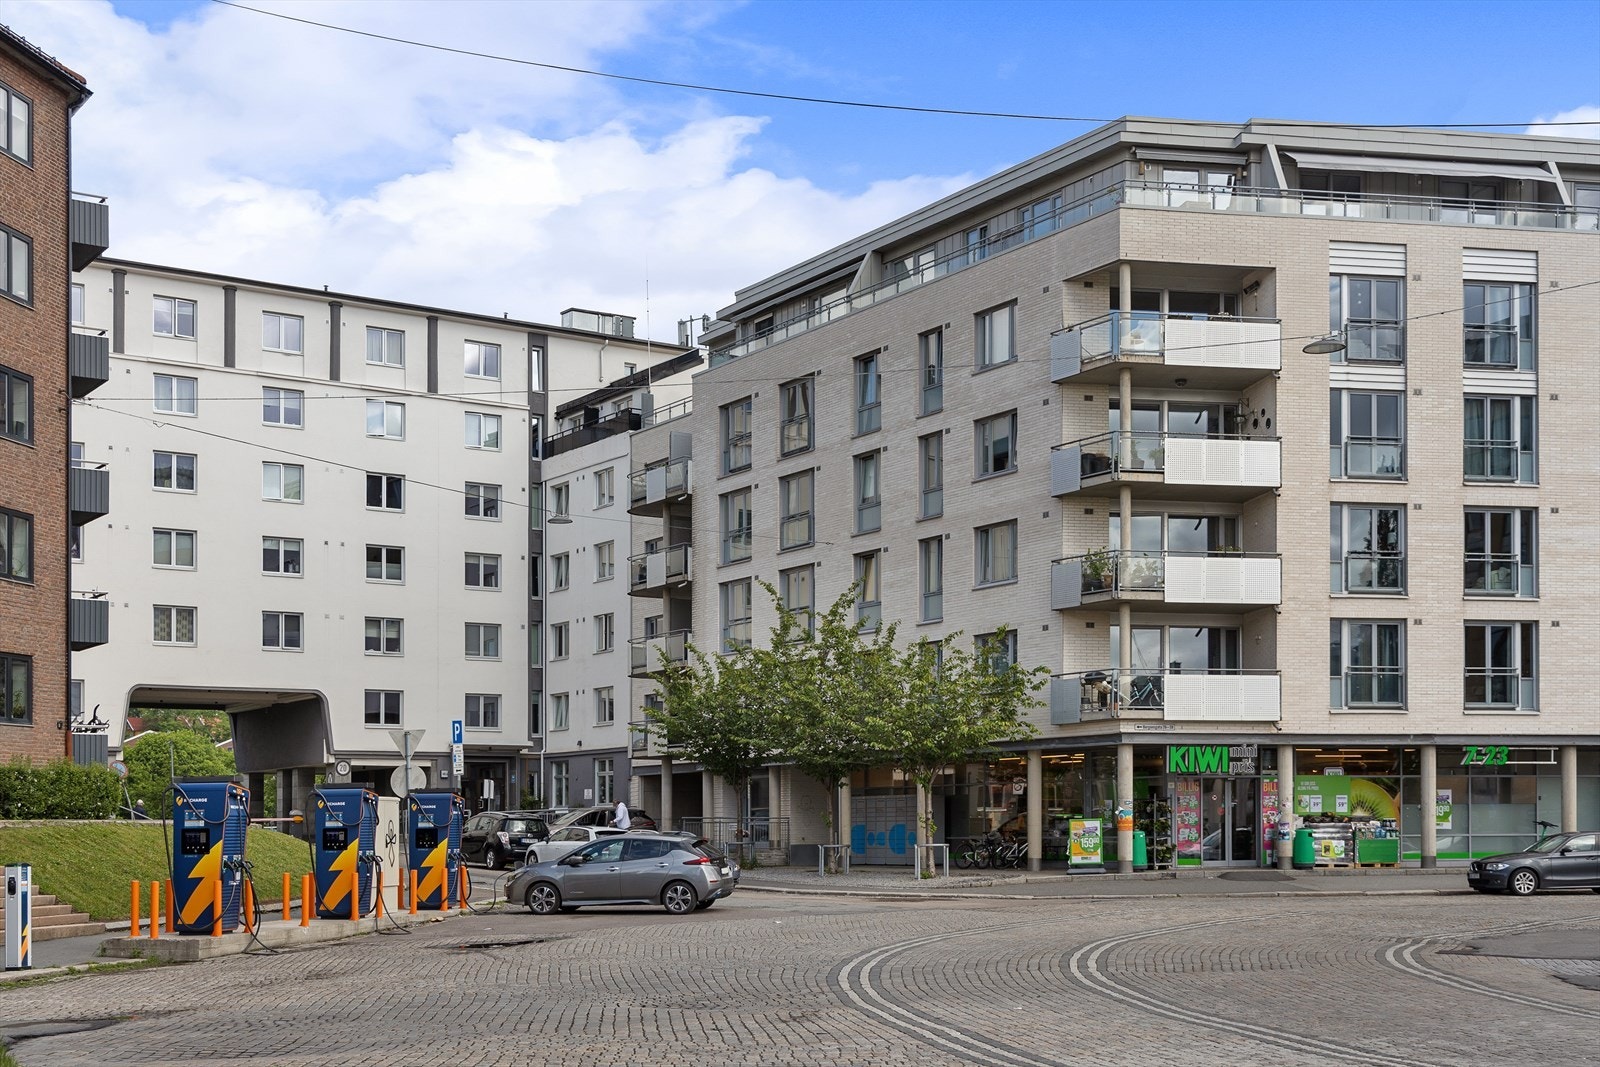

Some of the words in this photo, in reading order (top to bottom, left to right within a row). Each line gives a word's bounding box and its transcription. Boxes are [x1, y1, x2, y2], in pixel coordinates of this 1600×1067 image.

[1169, 746, 1229, 773] KIWI
[1229, 744, 1258, 757] mini
[1461, 746, 1509, 765] 7-23
[339, 764, 347, 773] 20
[1229, 759, 1255, 775] pris
[1177, 782, 1200, 792] BILLIG
